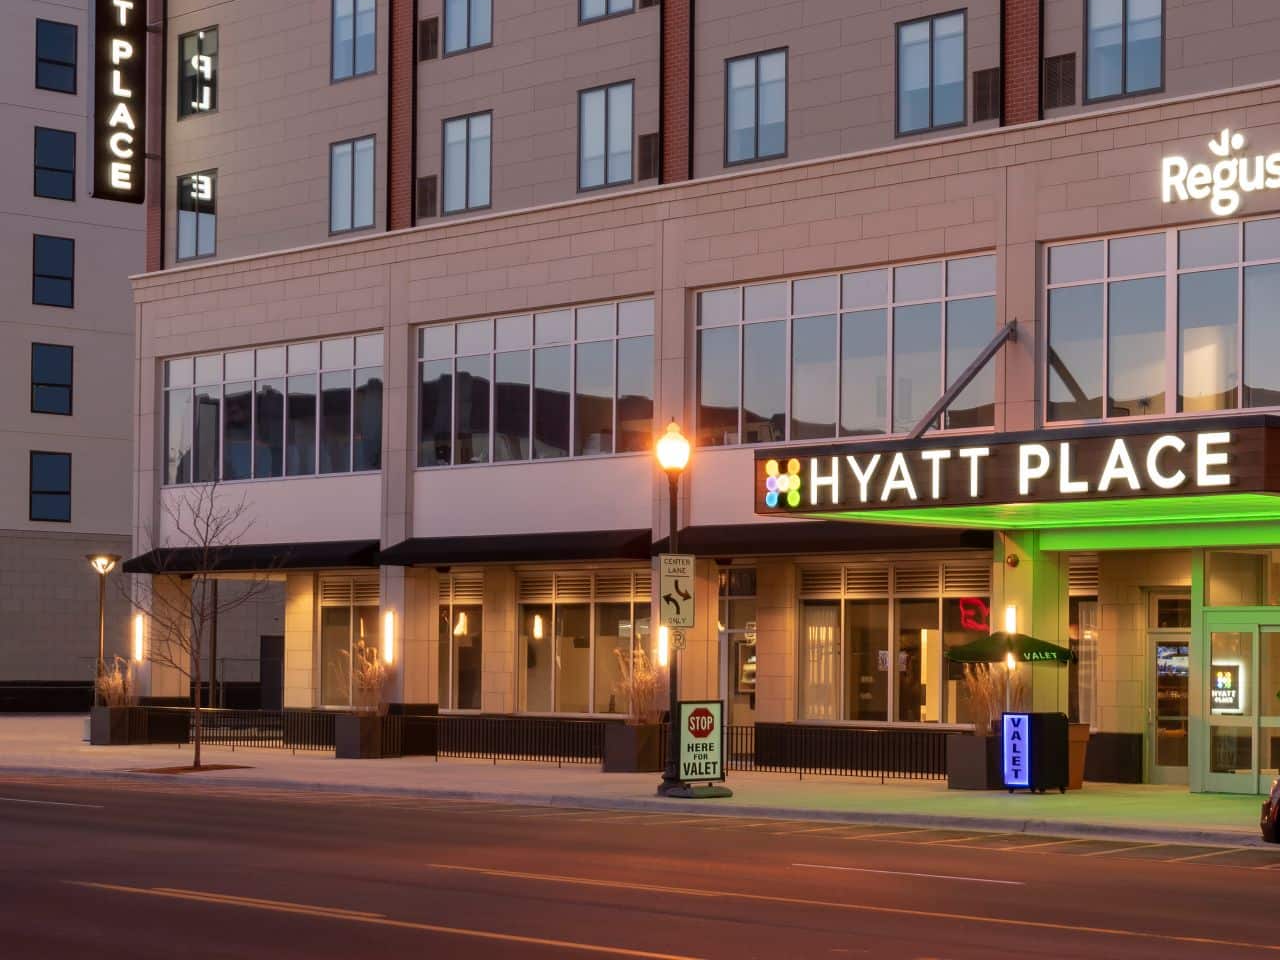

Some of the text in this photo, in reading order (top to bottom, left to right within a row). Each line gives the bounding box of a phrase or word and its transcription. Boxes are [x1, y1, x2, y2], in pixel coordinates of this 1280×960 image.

[109, 38, 136, 190] PLACE
[809, 431, 1231, 505] HYATT PLACE
[664, 558, 691, 566] CENTER
[667, 617, 687, 625] ONLY
[1023, 651, 1057, 660] VALET
[690, 716, 713, 730] STOP
[687, 742, 715, 753] HERE
[1010, 717, 1022, 779] VALET
[683, 761, 718, 776] VALET
